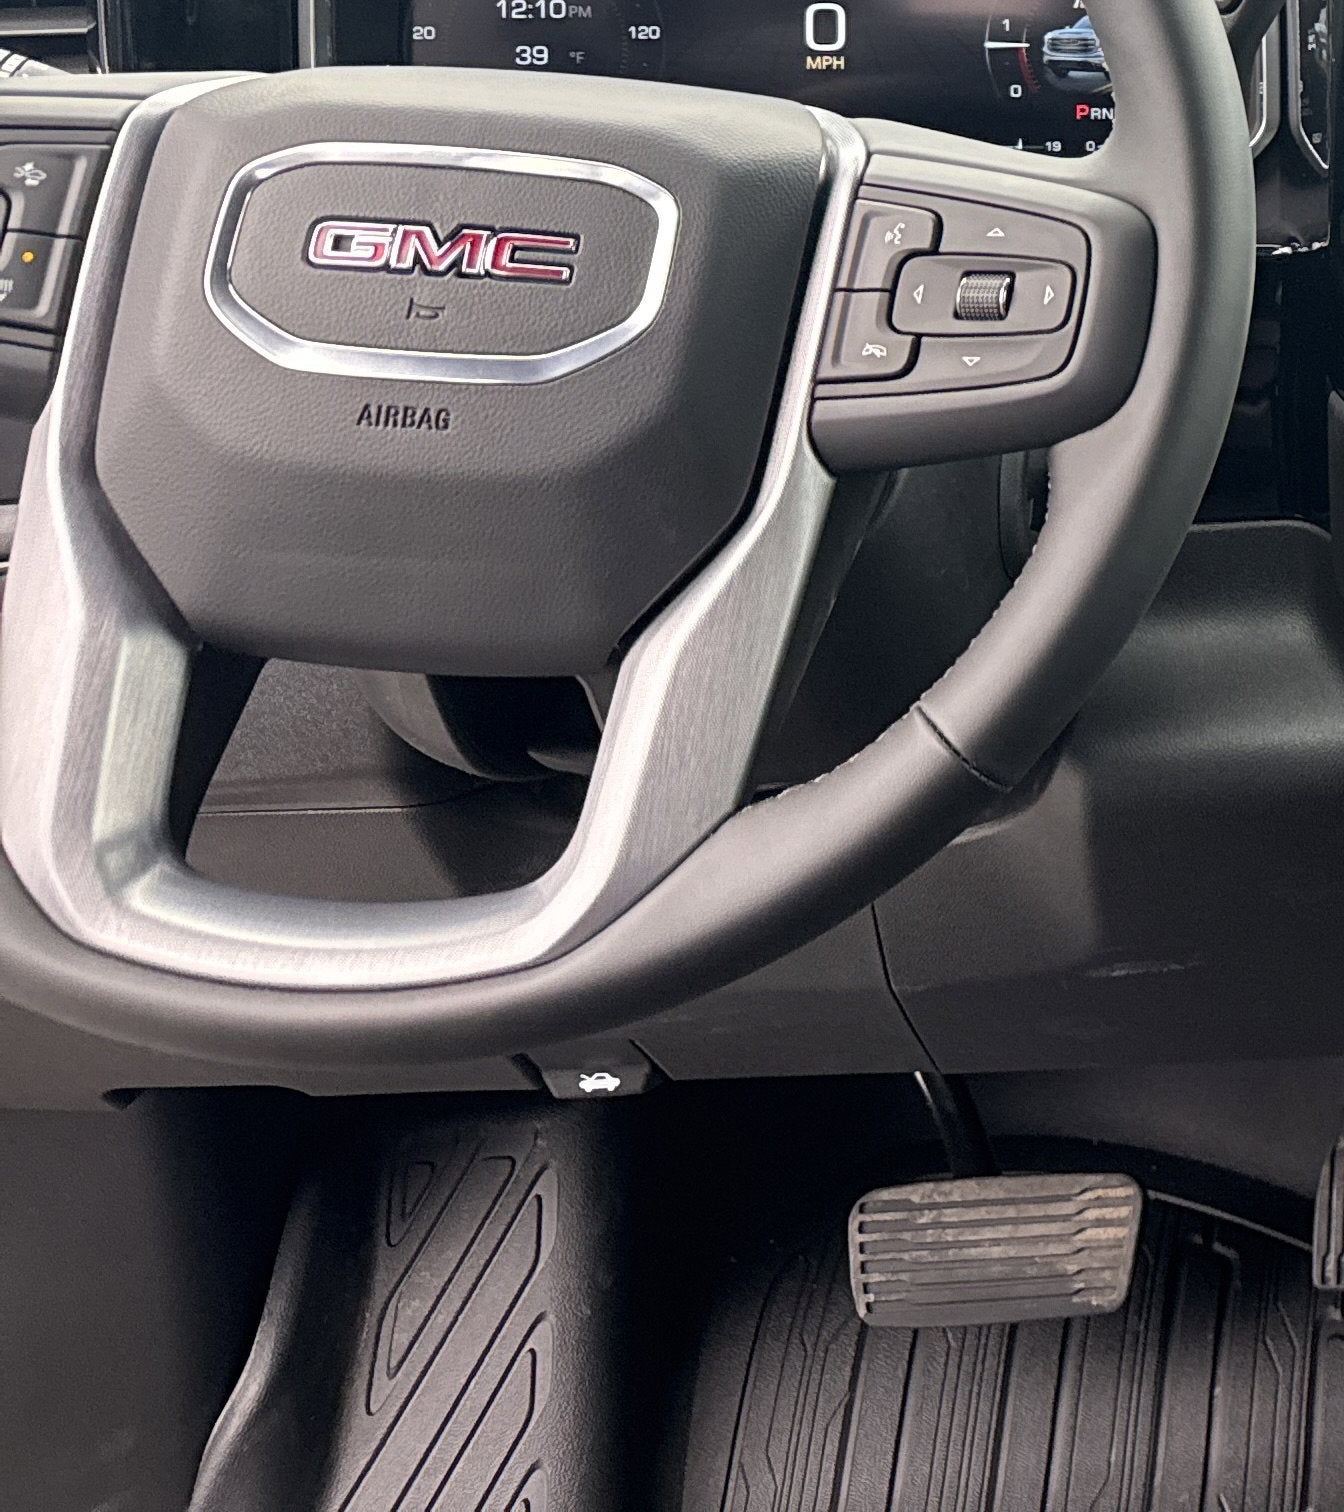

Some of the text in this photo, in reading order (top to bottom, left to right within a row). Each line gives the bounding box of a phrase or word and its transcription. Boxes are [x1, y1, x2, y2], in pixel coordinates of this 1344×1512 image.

[568, 6, 592, 18] PM
[628, 25, 661, 40] 120
[805, 2, 846, 51] 0
[1002, 18, 1011, 32] 1
[412, 26, 436, 40] 20
[515, 45, 549, 66] 39
[805, 55, 845, 70] MPH
[1009, 84, 1022, 98] 0
[1045, 140, 1062, 153] 19
[307, 219, 582, 284] GMC
[356, 402, 451, 431] AIRBAG
